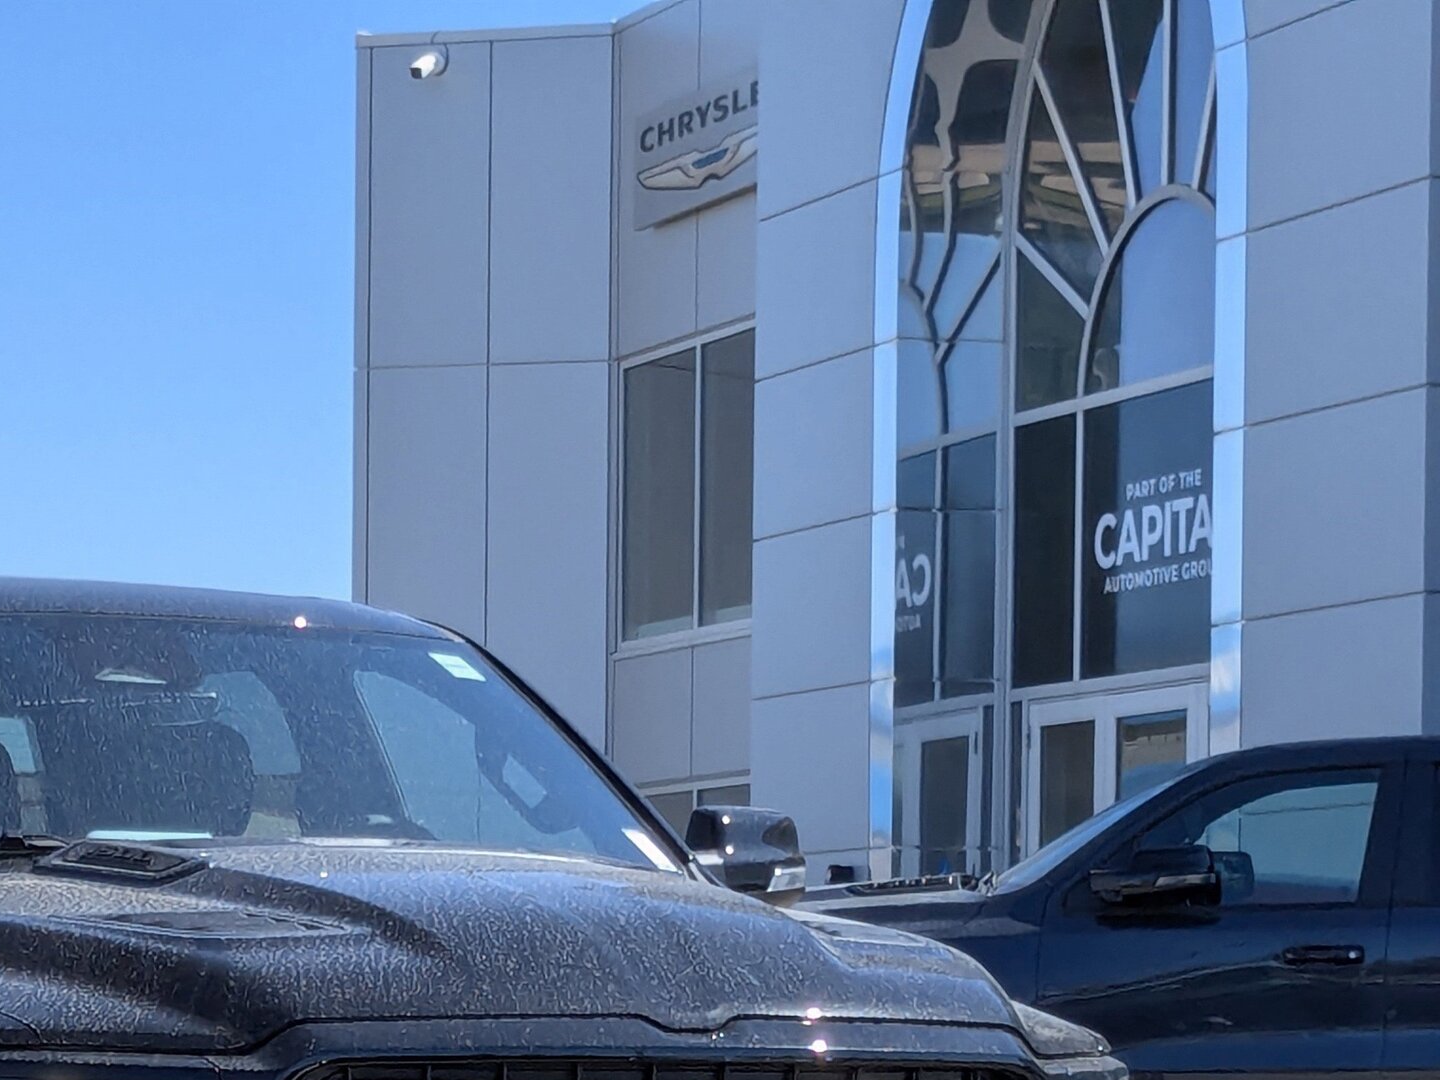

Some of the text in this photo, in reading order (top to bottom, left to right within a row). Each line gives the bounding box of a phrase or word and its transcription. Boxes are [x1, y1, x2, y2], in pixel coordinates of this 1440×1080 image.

[1125, 468, 1202, 501] PART OF THE
[1103, 563, 1179, 595] AUTOMOTIVE
